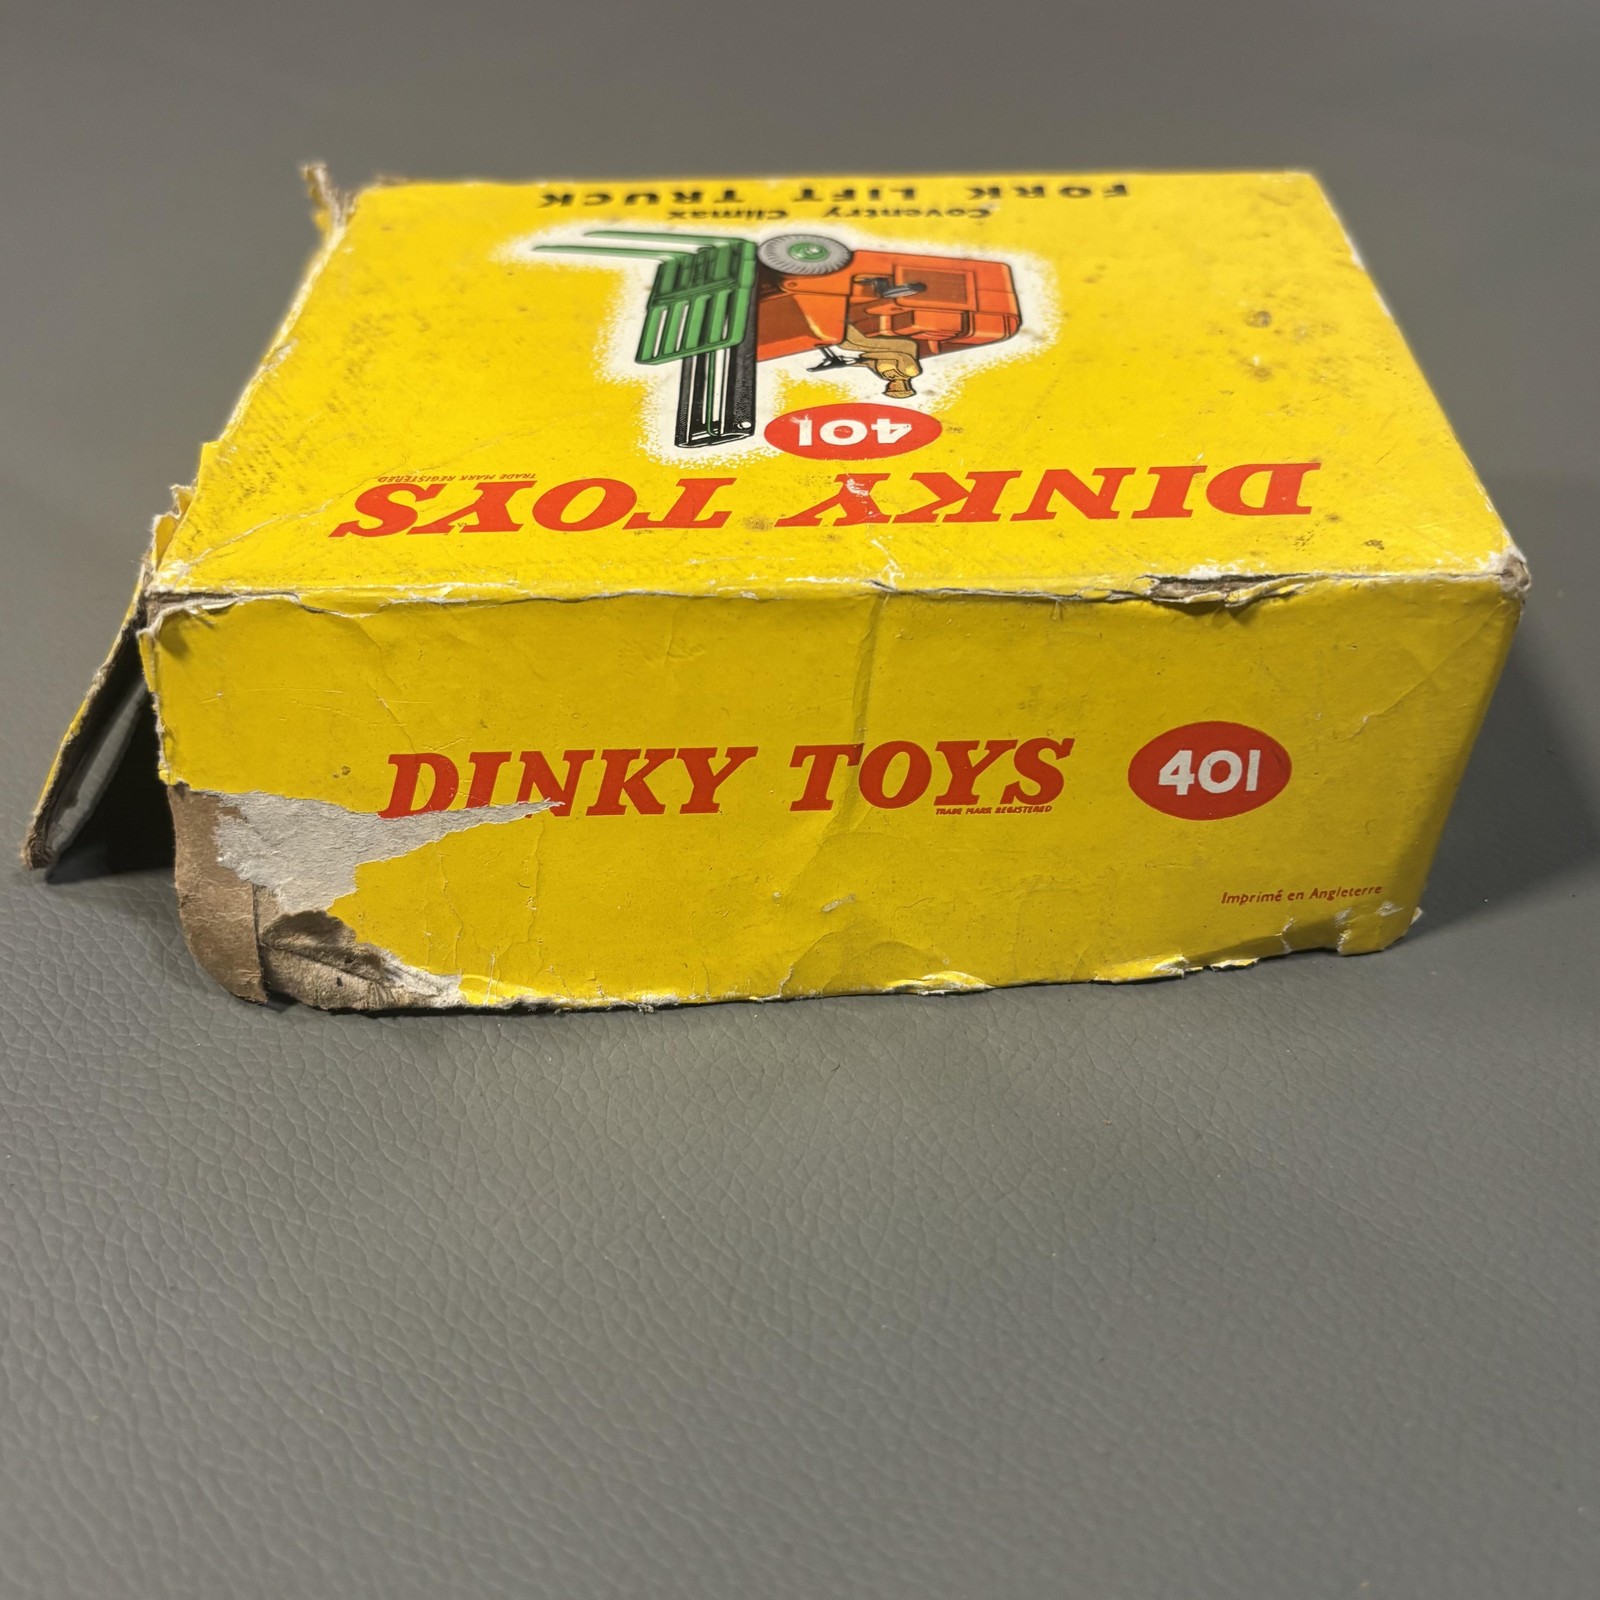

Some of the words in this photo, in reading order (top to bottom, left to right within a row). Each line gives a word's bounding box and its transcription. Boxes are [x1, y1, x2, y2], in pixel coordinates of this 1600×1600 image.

[537, 188, 746, 208] TRUCK
[793, 187, 915, 202] LIFT
[966, 185, 1128, 199] FORK
[667, 209, 788, 220] Climax
[823, 206, 991, 219] Coventry
[798, 418, 913, 447] 401
[377, 475, 457, 483] REGISTERED
[773, 462, 1322, 528] DINKY
[328, 477, 738, 538] TOYS
[377, 746, 759, 819] DINKY
[789, 737, 1075, 811] TOYS
[1158, 749, 1262, 796] 401
[935, 807, 963, 816] TRADE
[965, 806, 993, 815] MARK
[995, 805, 1053, 814] REGISTERED
[1221, 889, 1284, 906] Imprimé
[1287, 890, 1305, 901] en
[1308, 886, 1383, 901] Angleterre
